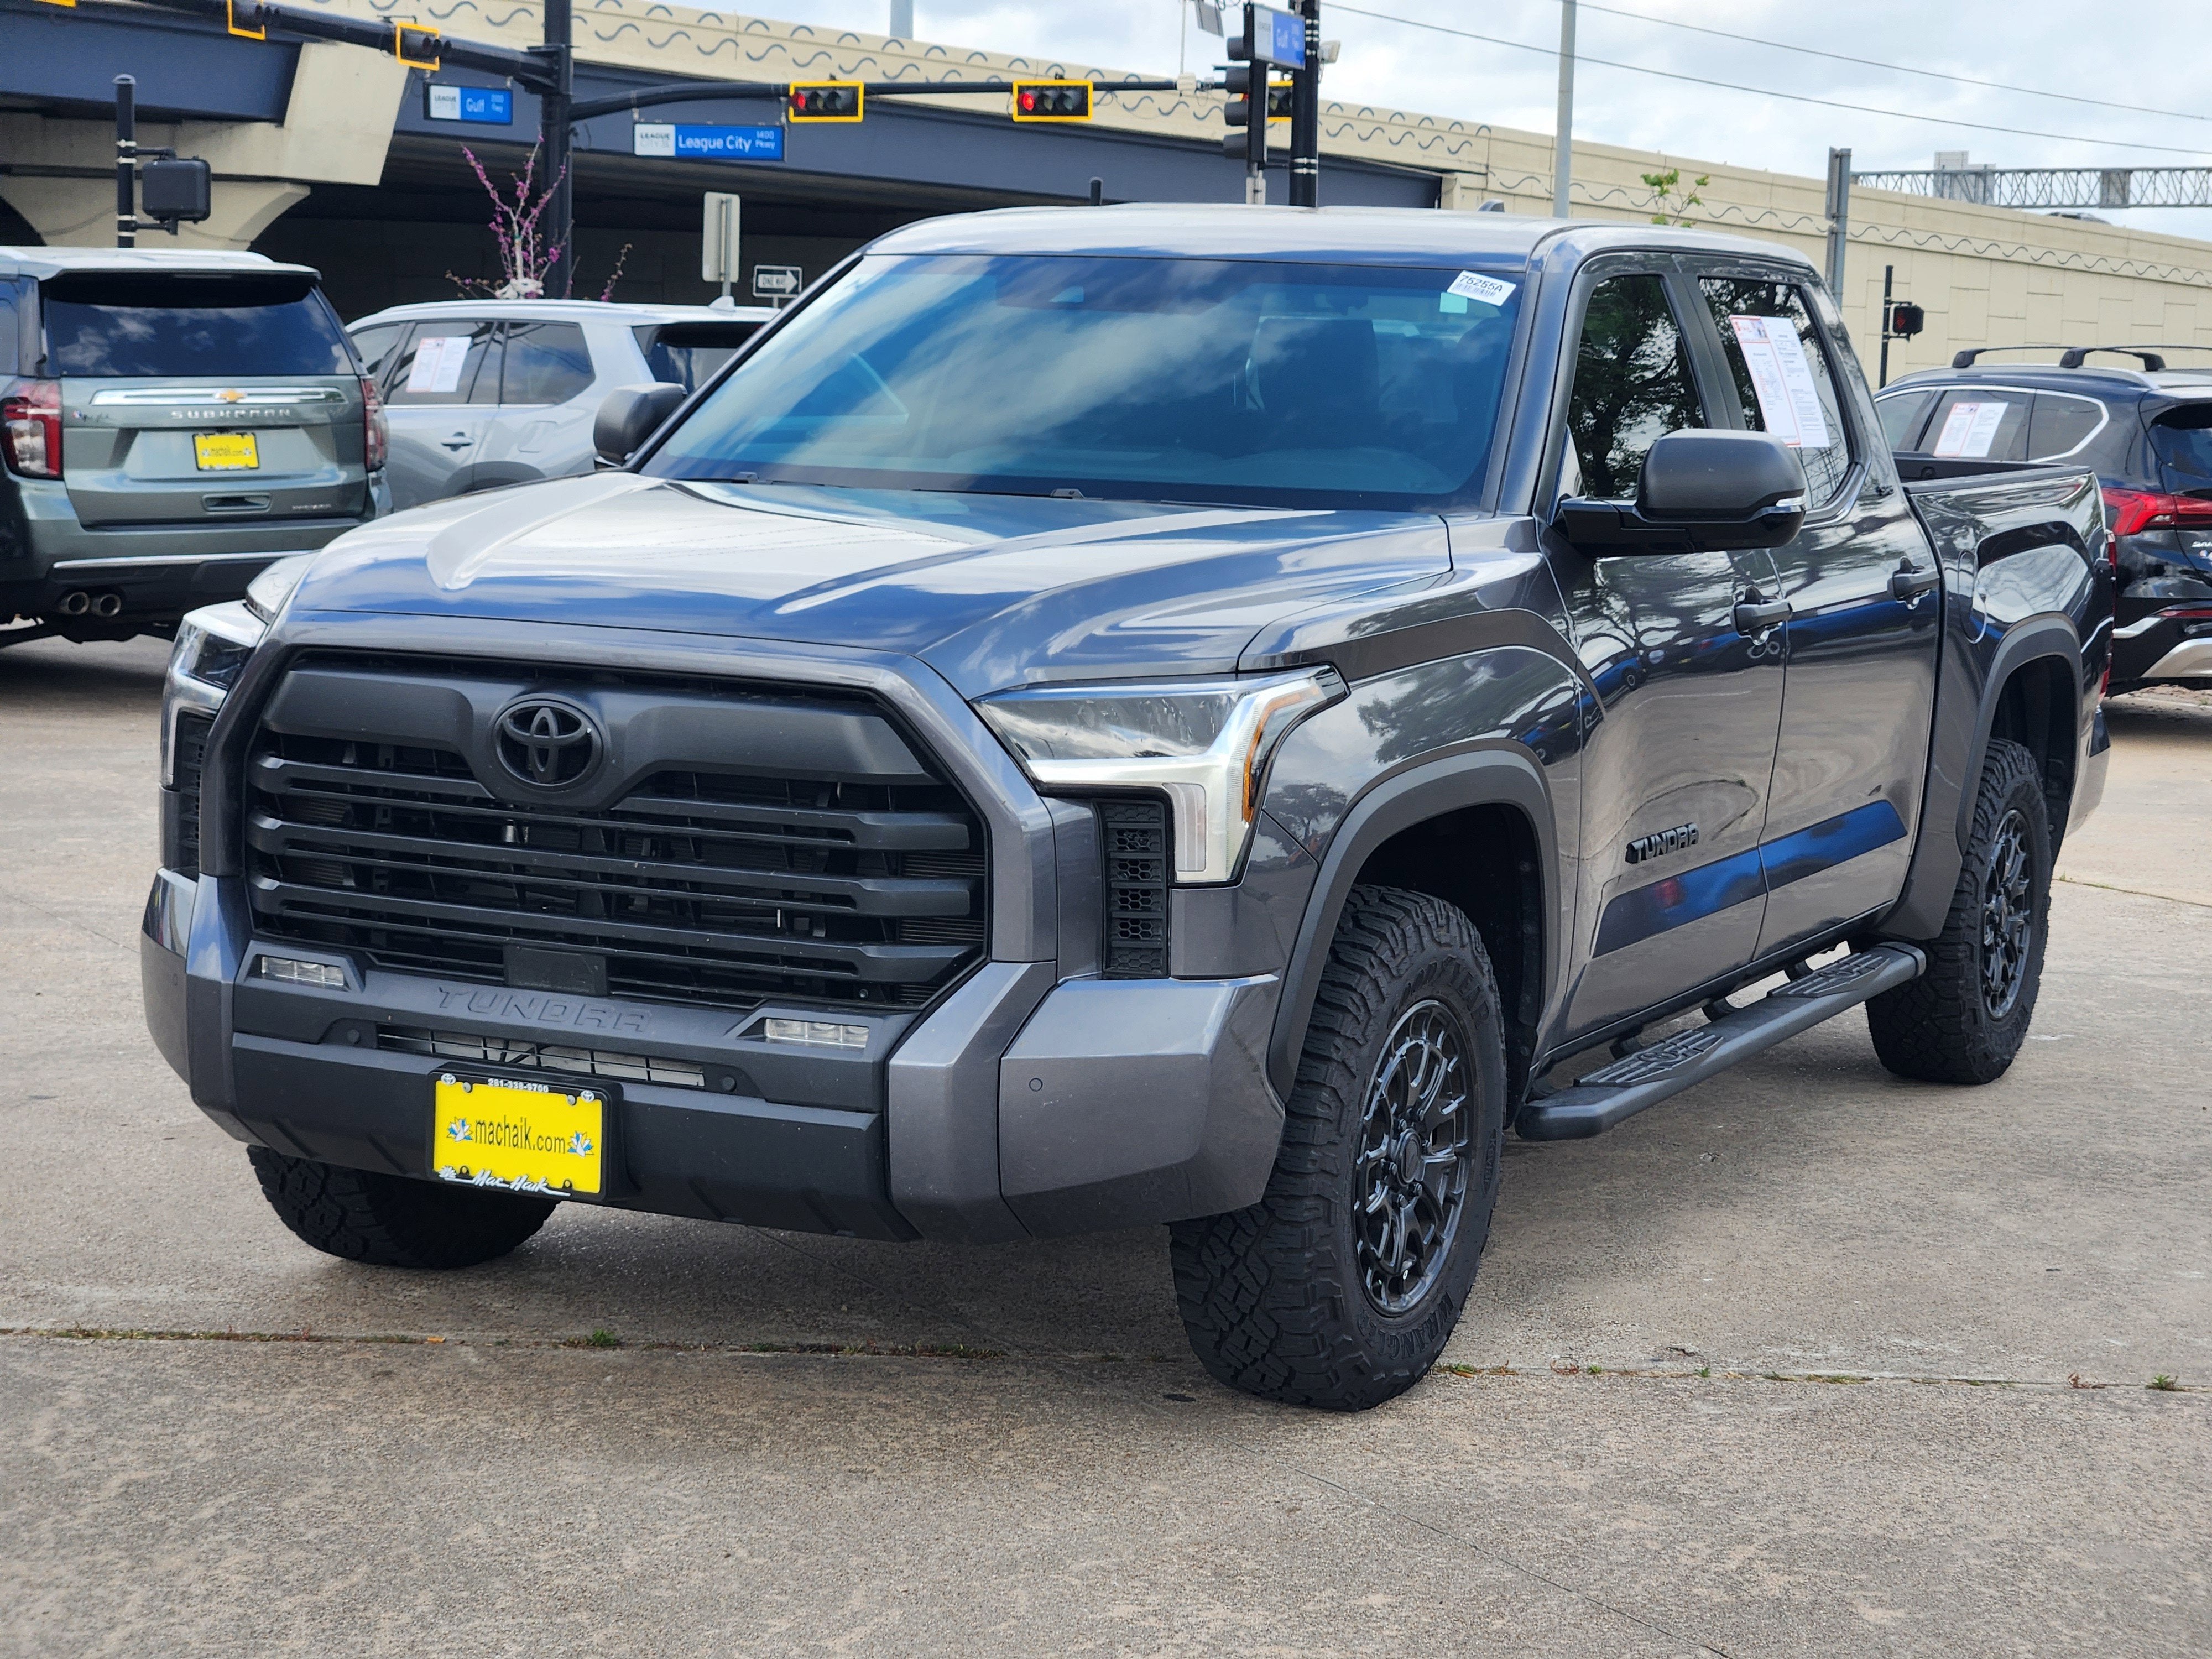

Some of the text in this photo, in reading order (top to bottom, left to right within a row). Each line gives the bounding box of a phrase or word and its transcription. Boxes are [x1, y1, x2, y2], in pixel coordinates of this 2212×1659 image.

[465, 97, 485, 113] Gulf
[677, 134, 752, 153] League City
[171, 409, 291, 419] SUBURBAN
[1625, 822, 1699, 863] TUNDRA
[439, 987, 653, 1032] TUNDRA
[474, 1115, 566, 1154] machaik.com
[471, 1169, 554, 1193] Mac Haik
[1358, 1292, 1454, 1360] WRANGLER
